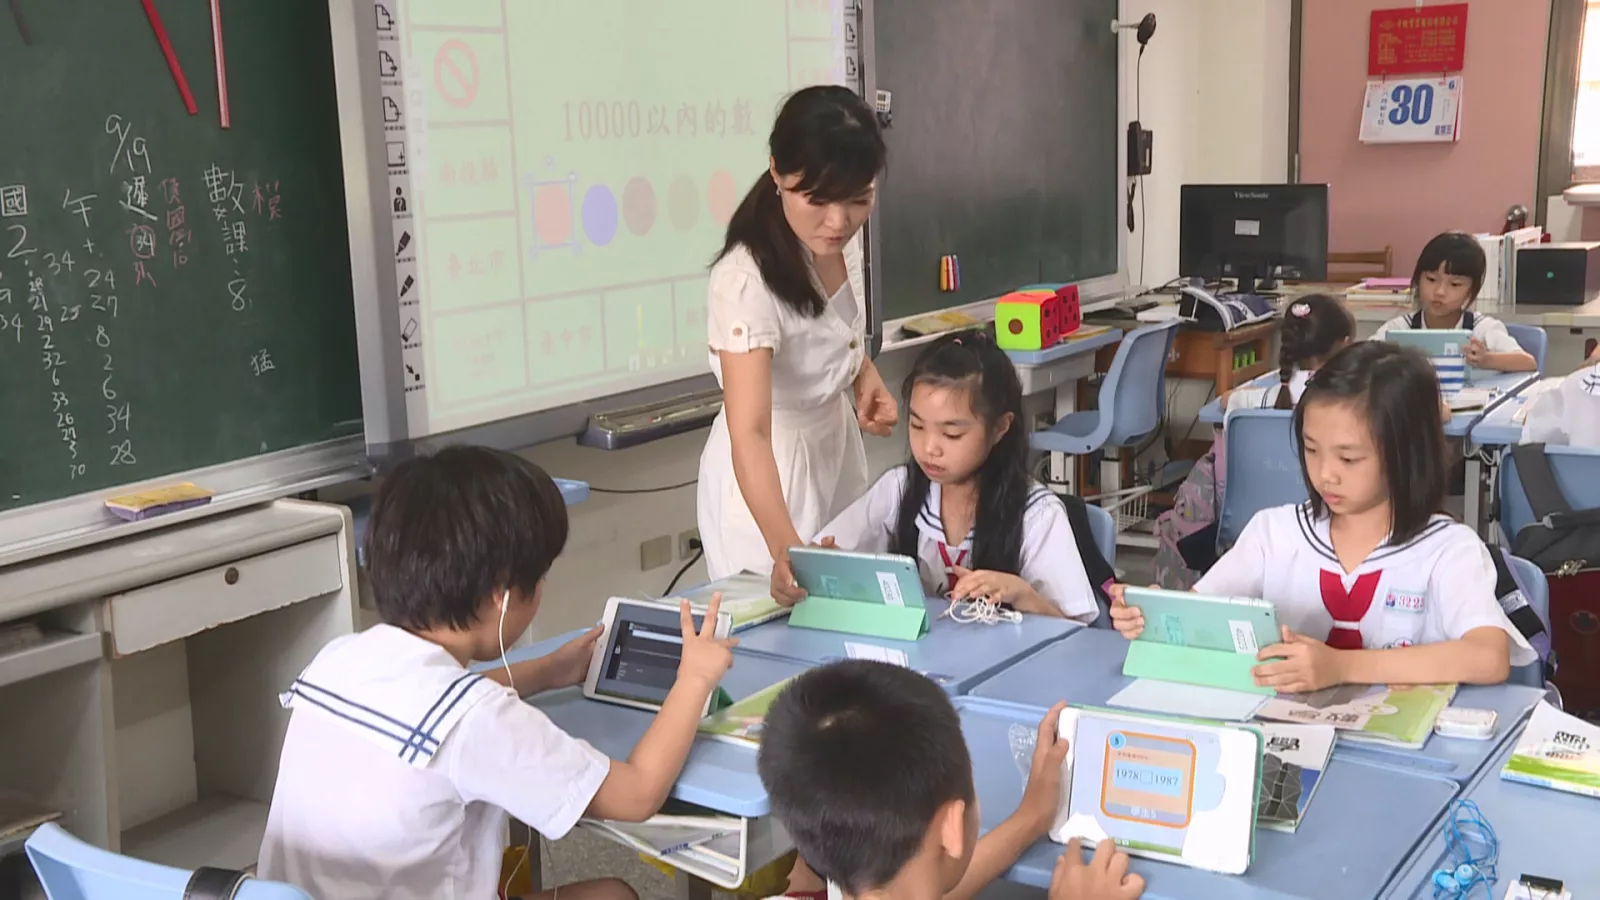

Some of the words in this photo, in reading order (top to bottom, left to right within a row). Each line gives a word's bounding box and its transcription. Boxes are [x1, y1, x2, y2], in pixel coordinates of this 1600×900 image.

[1388, 84, 1434, 125] 30
[43, 250, 76, 276] 34
[84, 268, 116, 290] 24
[41, 334, 55, 350] 2
[95, 324, 111, 348] 8
[42, 351, 67, 371] 32
[103, 353, 114, 371] 2
[52, 367, 60, 387] 6
[102, 373, 117, 400] 6
[51, 391, 69, 413] 33
[56, 412, 75, 428] 26
[106, 402, 131, 435] 34
[109, 438, 137, 466] 28
[1116, 768, 1139, 782] 1978
[1155, 774, 1180, 788] 1987
